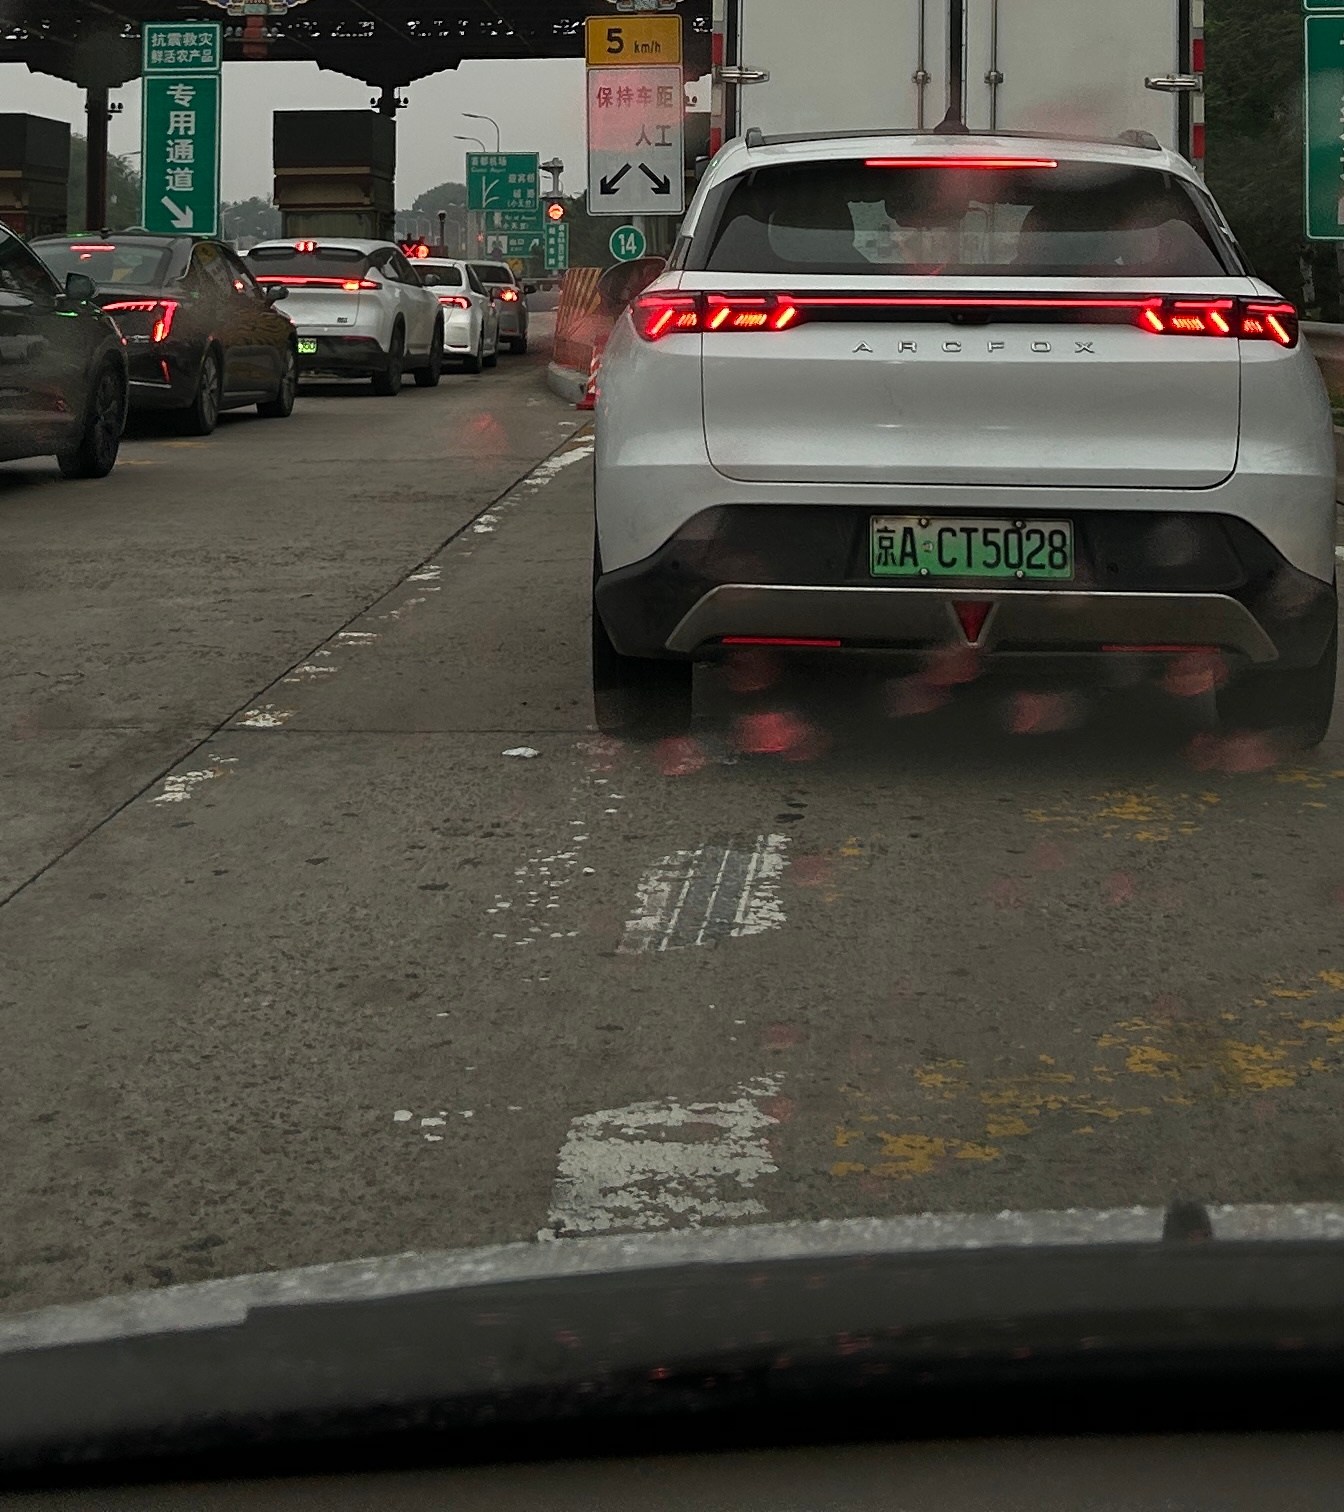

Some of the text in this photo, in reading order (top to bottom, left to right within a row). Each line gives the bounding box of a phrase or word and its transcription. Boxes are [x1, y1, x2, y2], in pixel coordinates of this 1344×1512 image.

[151, 32, 213, 47] 抗震救灾
[606, 28, 661, 54] 5 km/h
[151, 49, 213, 63] 鲜活农产品
[596, 86, 674, 109] 保持车距
[166, 83, 196, 192] 专用通道
[635, 124, 672, 147] 人工
[618, 233, 637, 254] 14
[852, 341, 1095, 354] ARCFOX
